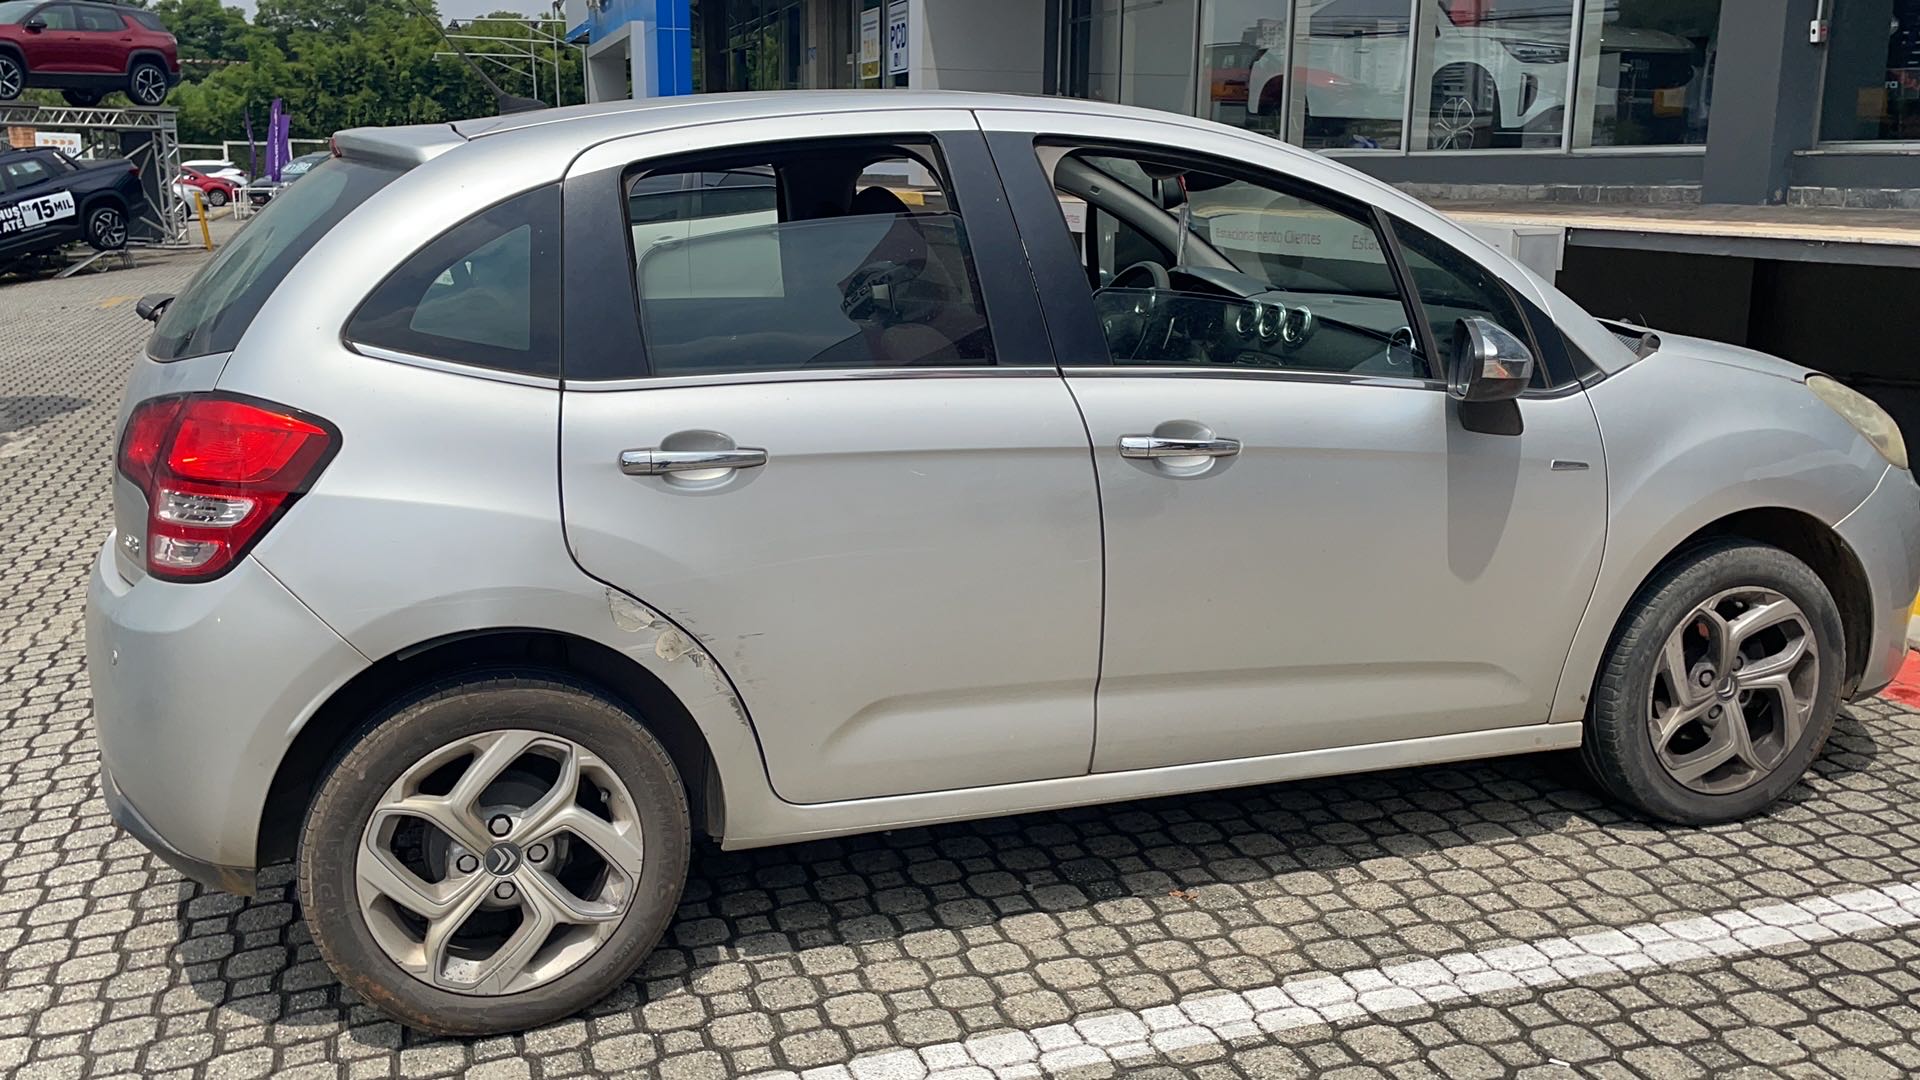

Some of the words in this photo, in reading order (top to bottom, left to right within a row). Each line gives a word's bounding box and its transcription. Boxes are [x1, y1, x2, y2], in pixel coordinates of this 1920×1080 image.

[890, 23, 907, 51] PCD
[0, 206, 21, 221] NUS
[32, 199, 55, 220] 15
[53, 199, 73, 212] MIL
[1215, 227, 1283, 244] Estacionamento
[1284, 230, 1322, 246] Clientes
